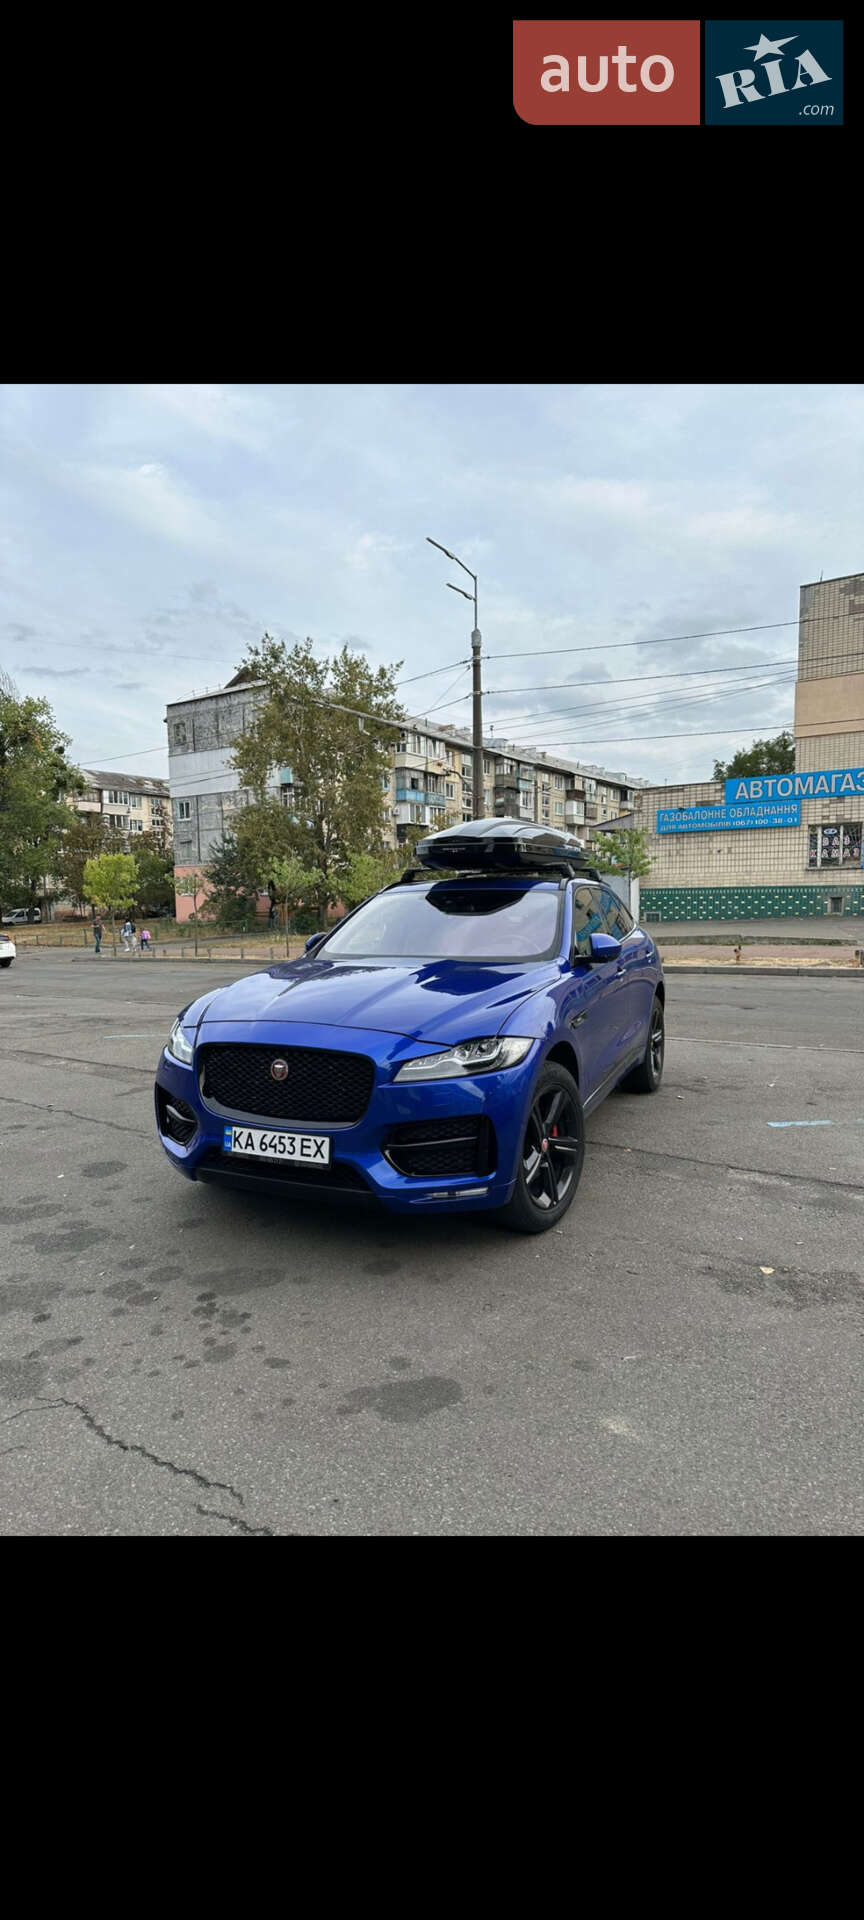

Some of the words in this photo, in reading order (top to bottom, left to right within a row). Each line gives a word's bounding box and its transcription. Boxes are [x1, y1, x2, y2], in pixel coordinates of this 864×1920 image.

[659, 809, 727, 822] ГАЗОБАЛОННЕ
[729, 804, 798, 818] ОБЛАДНАННЯ
[233, 1130, 255, 1151] KA
[259, 1134, 296, 1156] 6453
[300, 1137, 326, 1160] EX
